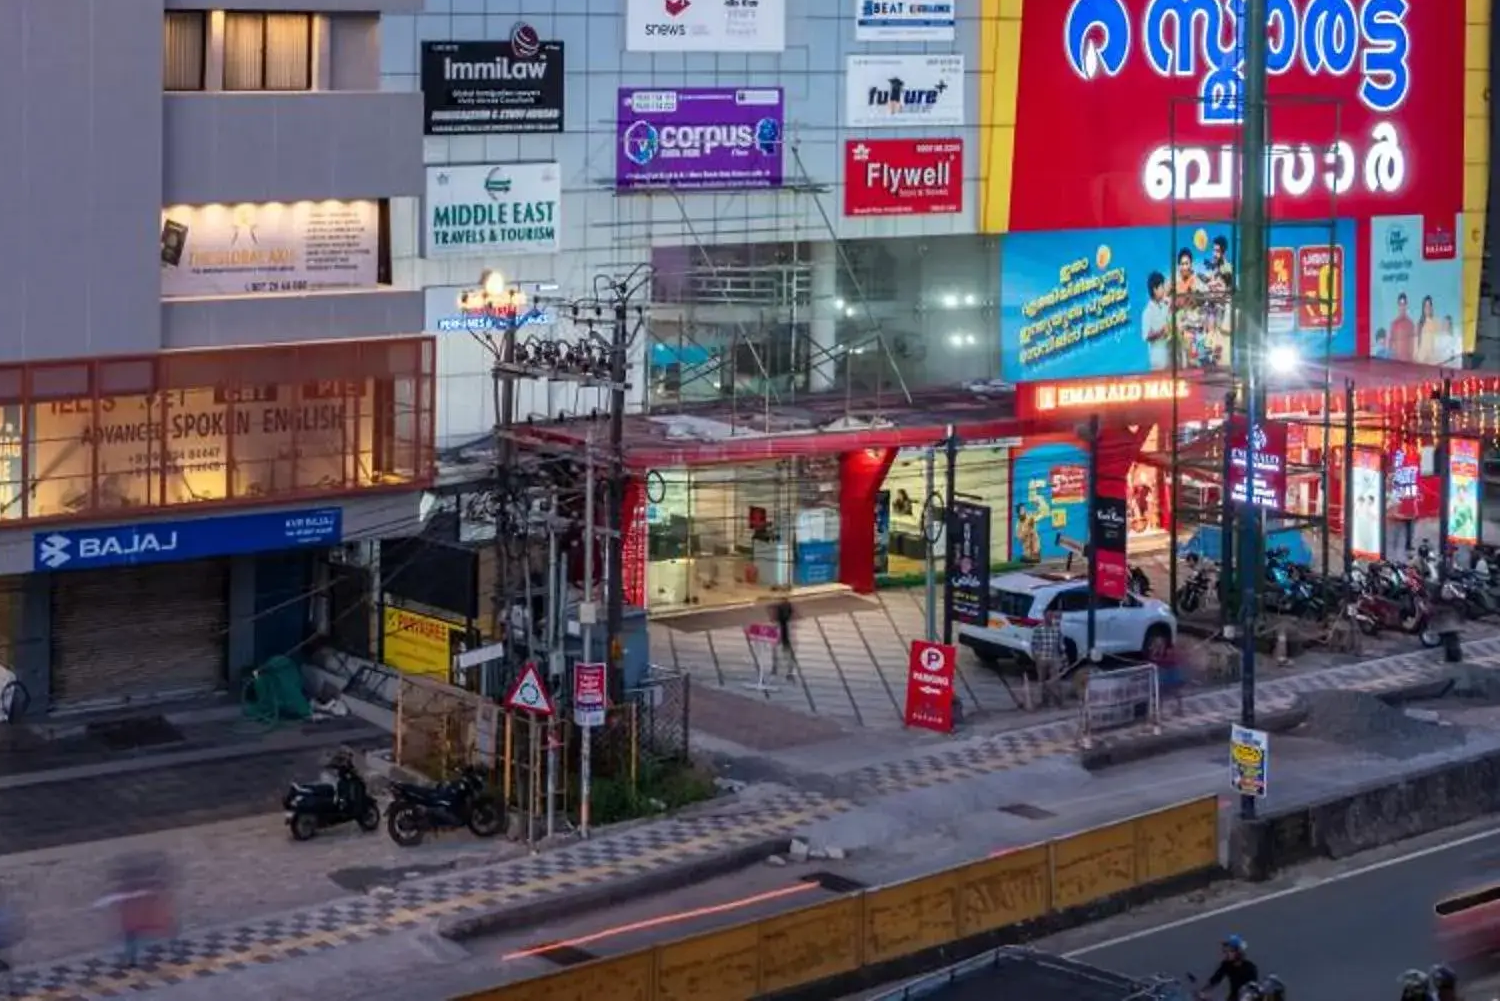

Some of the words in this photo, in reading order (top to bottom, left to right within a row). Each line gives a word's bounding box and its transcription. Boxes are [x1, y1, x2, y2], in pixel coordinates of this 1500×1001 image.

[444, 56, 547, 79] ImmiLaw
[660, 125, 752, 154] corpus
[867, 161, 949, 194] Flywell
[434, 204, 508, 227] MIDDLE
[513, 201, 555, 223] EAST
[434, 229, 485, 245] TRAVELS
[501, 226, 555, 241] TOURISM
[79, 531, 178, 557] BAJAJ
[912, 672, 949, 687] PARKING
